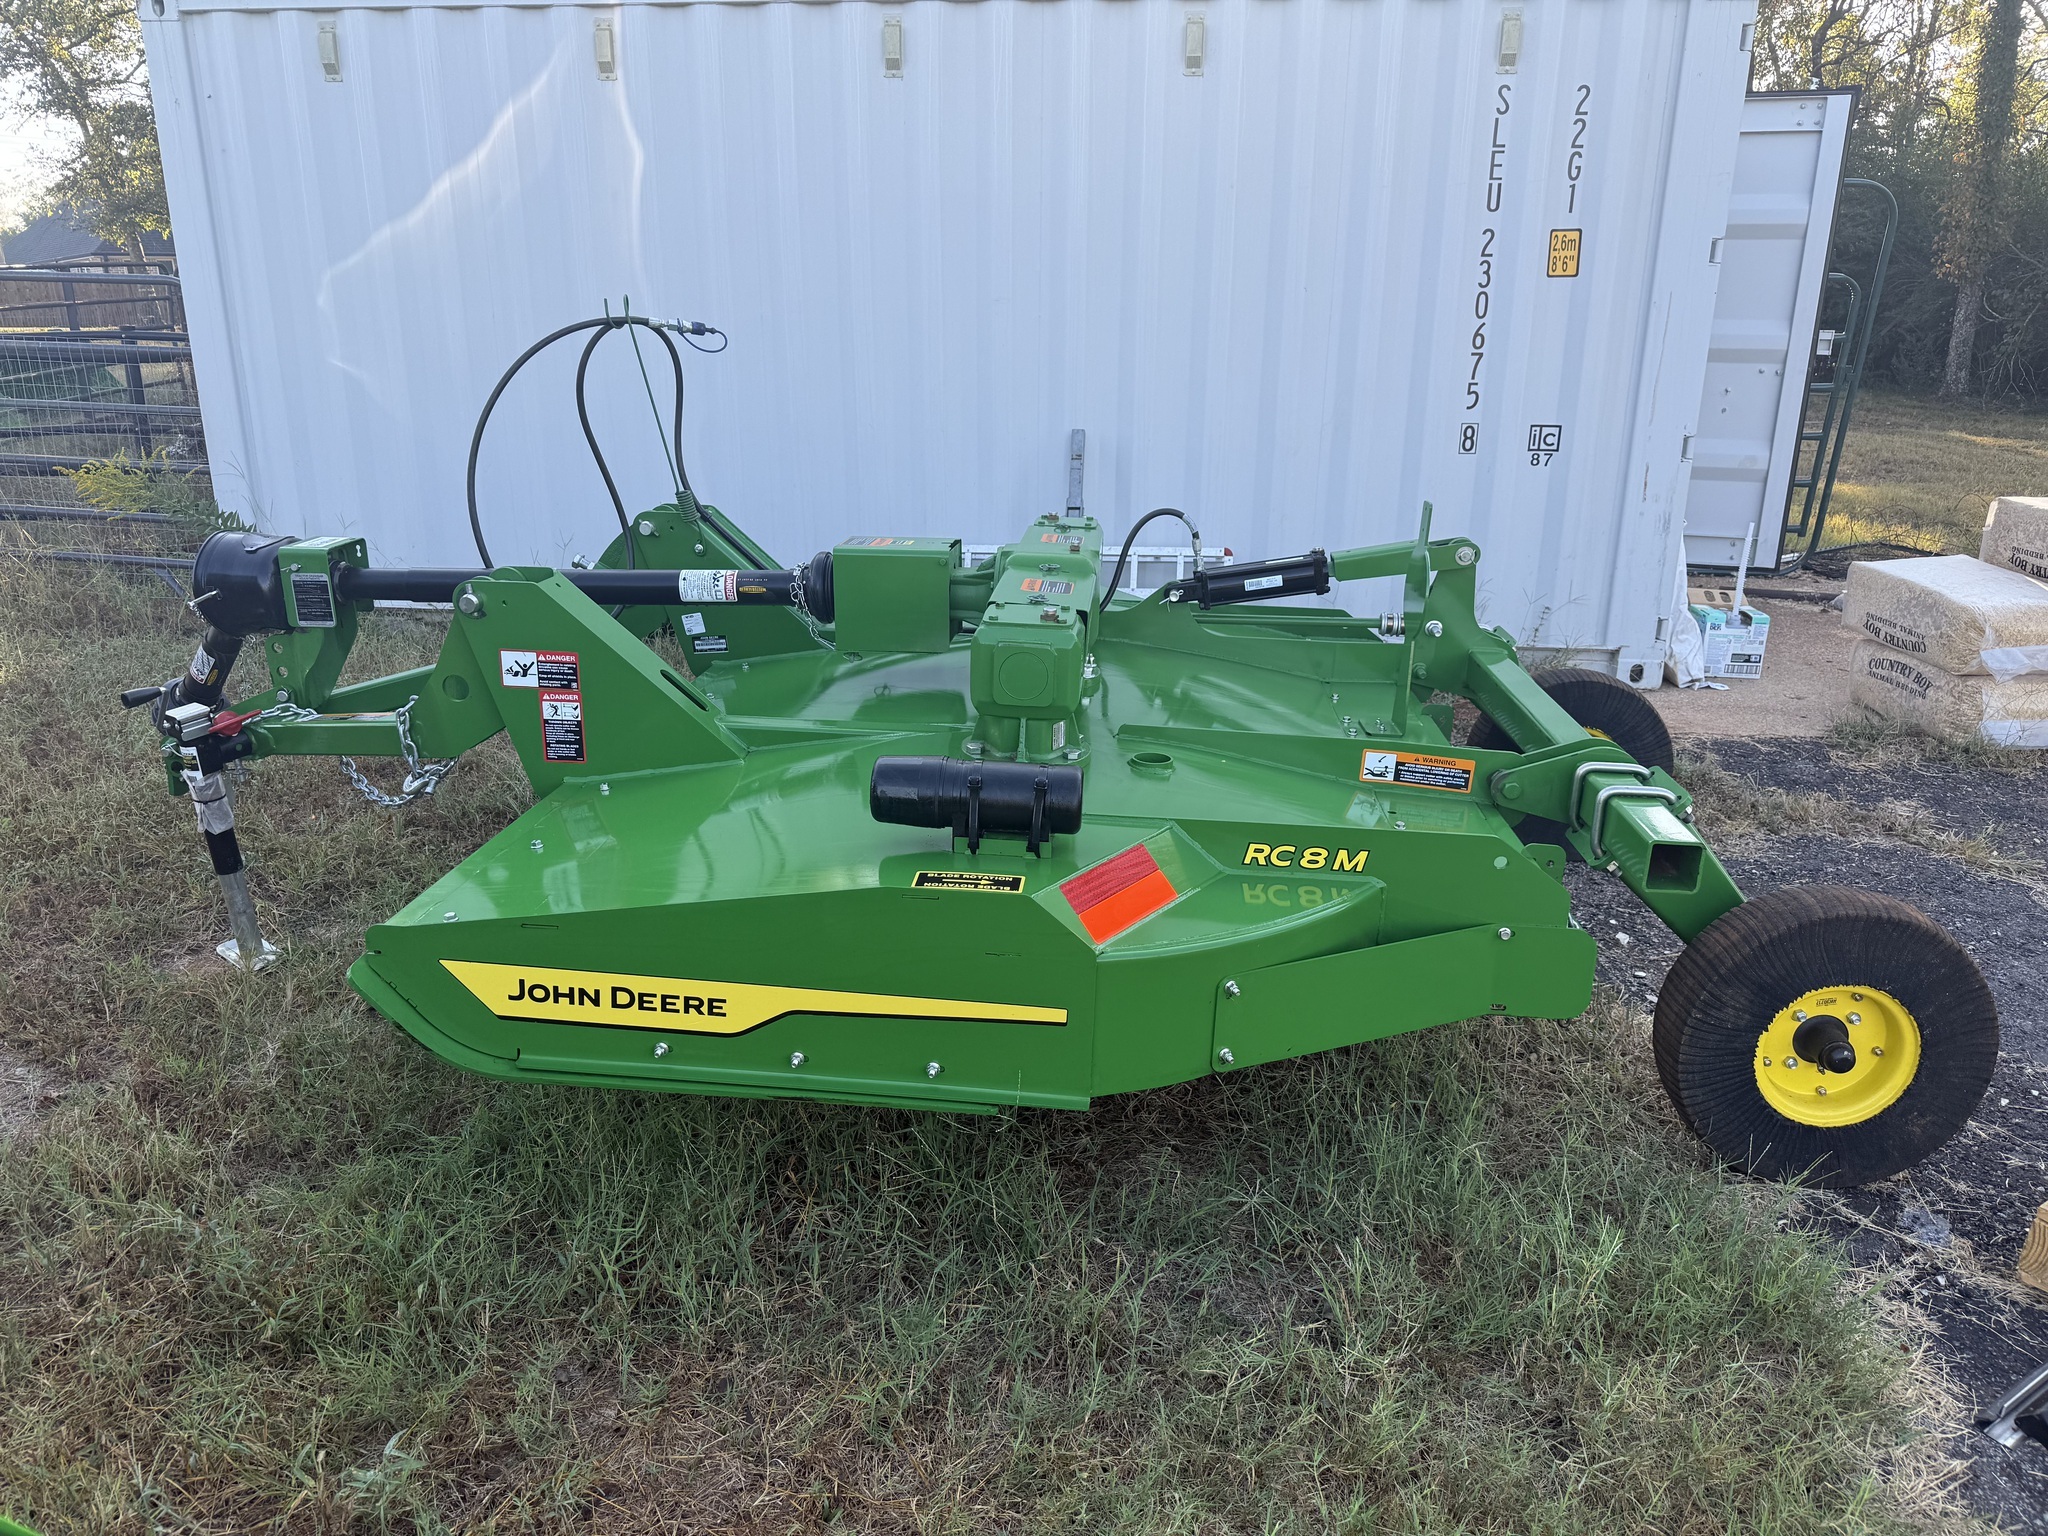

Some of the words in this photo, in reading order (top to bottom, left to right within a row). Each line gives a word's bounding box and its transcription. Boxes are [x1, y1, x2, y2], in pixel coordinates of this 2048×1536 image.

[1486, 84, 1512, 213] SLEU
[1567, 84, 1591, 214] 22G1
[1552, 234, 1577, 255] 2,6m
[1466, 228, 1495, 410] 230675
[1461, 425, 1476, 452] 8
[2008, 553, 2028, 572] BOY
[2012, 546, 2044, 560] BEDDING
[1863, 619, 1881, 639] BOY
[1866, 612, 1897, 629] BEDDING
[1883, 631, 1926, 653] COUNTRY
[1899, 625, 1926, 640] ANIMAL
[1868, 670, 1893, 685] ANIMAL
[1895, 681, 1926, 699] BEDDING
[1869, 658, 1915, 678] COUNTRY
[1913, 671, 1933, 692] BOY
[1423, 757, 1456, 766] WARNING
[508, 978, 600, 1008] JOHN
[611, 986, 727, 1017] DEERE
